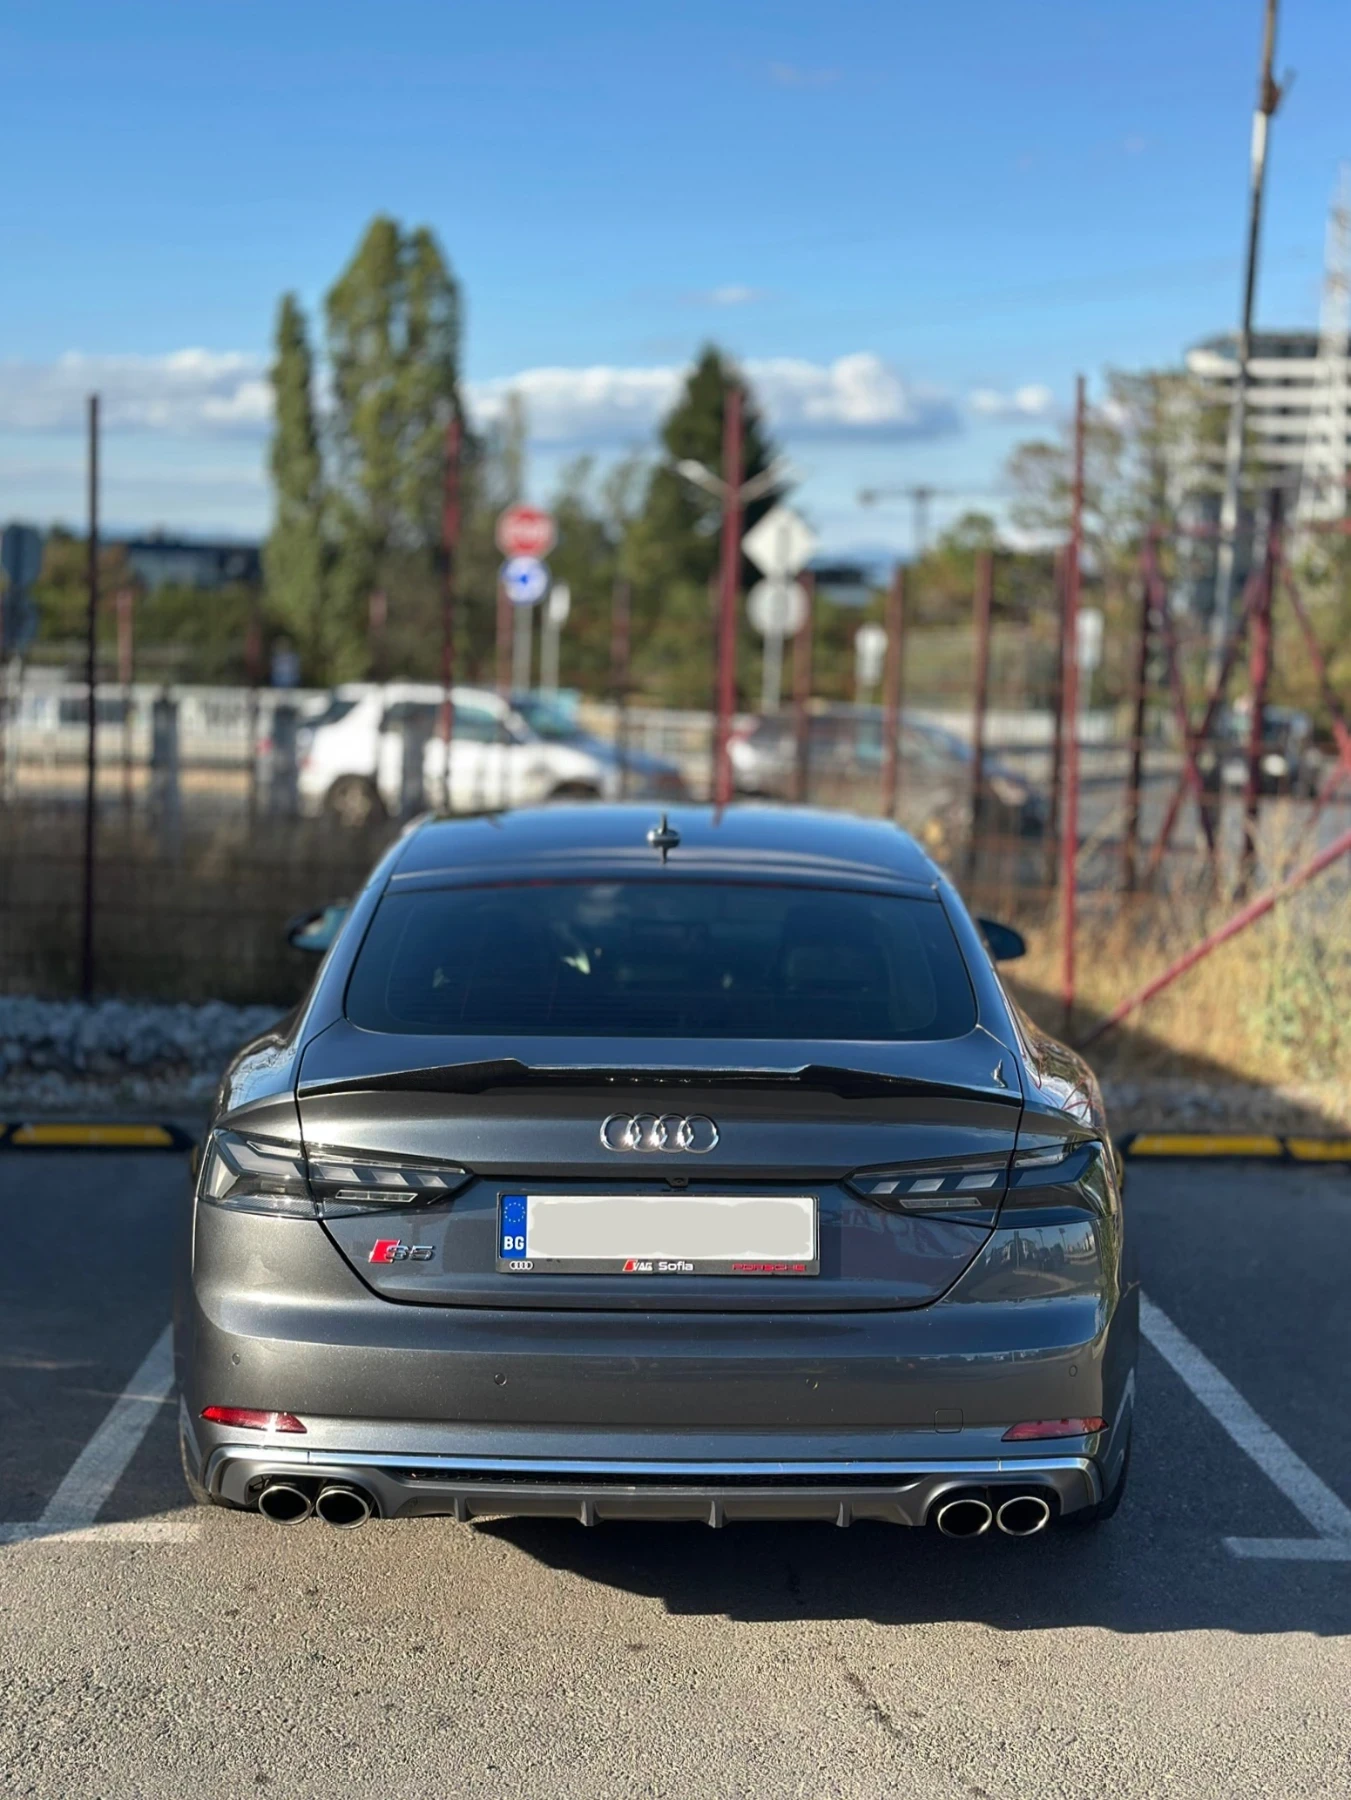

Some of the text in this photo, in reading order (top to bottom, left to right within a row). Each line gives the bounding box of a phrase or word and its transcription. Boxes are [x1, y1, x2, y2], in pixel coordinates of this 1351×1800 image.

[503, 1235, 525, 1250] BG
[380, 1243, 434, 1261] S5
[629, 1260, 694, 1272] VAG Sofia
[732, 1262, 807, 1272] PORSCHE
